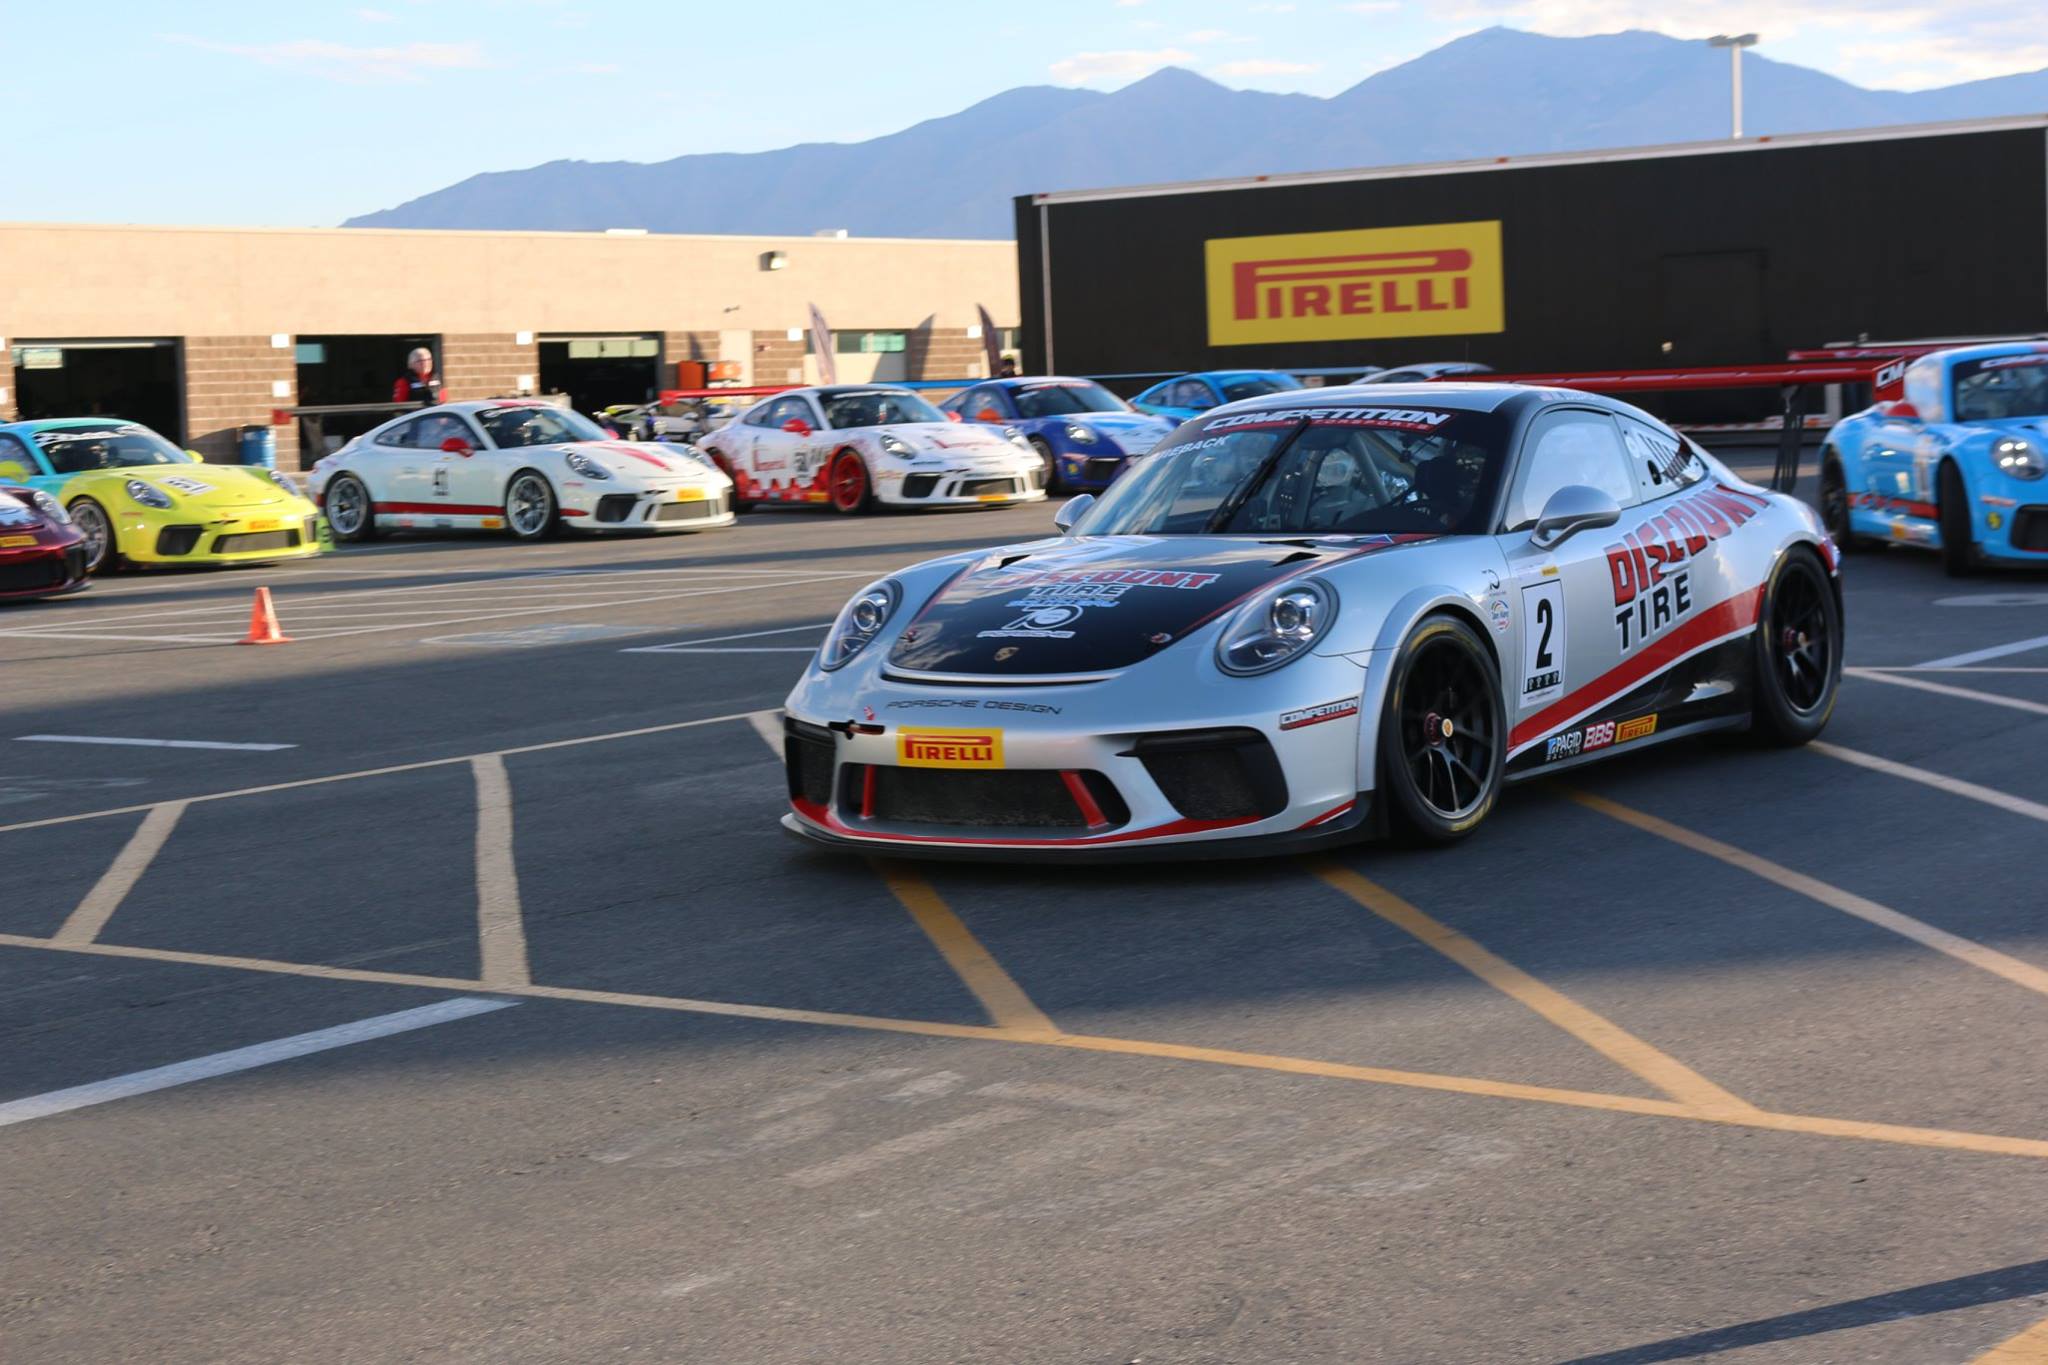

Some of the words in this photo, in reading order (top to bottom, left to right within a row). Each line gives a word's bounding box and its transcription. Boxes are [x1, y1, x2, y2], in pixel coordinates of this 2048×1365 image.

[1233, 248, 1472, 320] PIRELLI
[1202, 407, 1452, 431] COMPETITION
[984, 569, 1222, 590] DISCOUNT
[1029, 584, 1134, 598] TIRE
[1615, 572, 1692, 650] TIRE
[1536, 598, 1553, 669] 2
[885, 699, 979, 709] PORSCHE
[983, 700, 1063, 715] DESIGN
[1281, 699, 1357, 724] COMPETITION
[1583, 721, 1616, 748] BBS
[1620, 716, 1655, 741] PIRELLI
[904, 735, 993, 761] PIRELLI
[1557, 731, 1582, 753] PAGID
